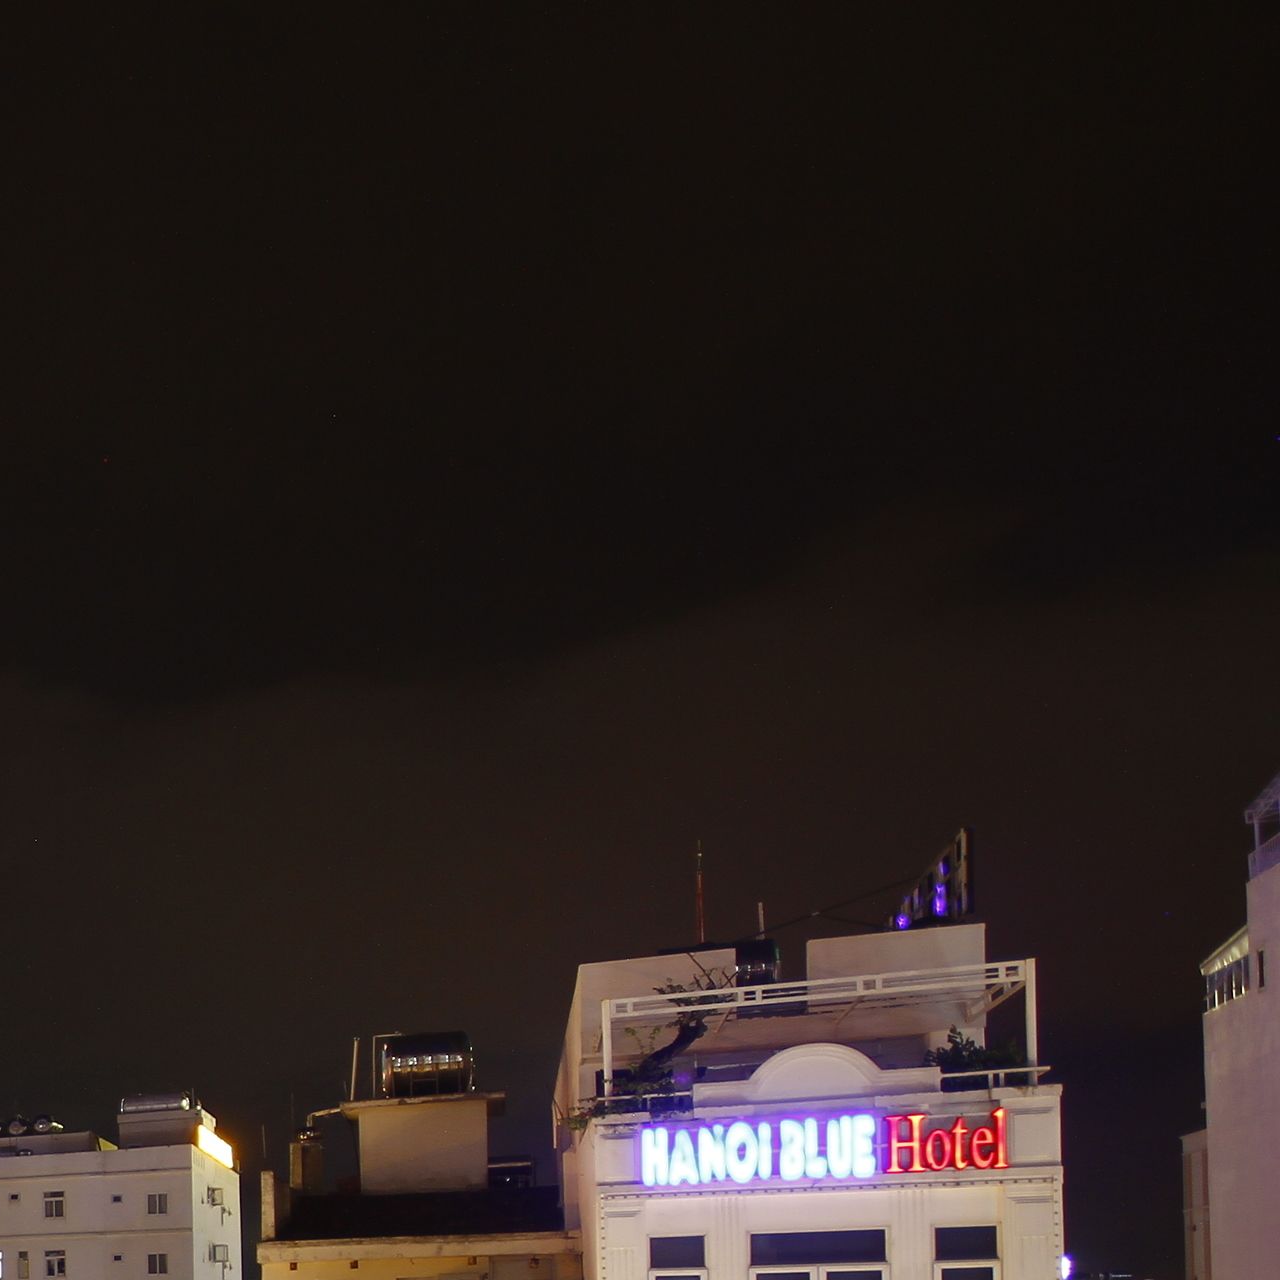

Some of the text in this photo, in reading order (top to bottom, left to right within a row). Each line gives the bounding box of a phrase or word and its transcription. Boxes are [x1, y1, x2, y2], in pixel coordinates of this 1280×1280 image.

[641, 1107, 1010, 1187] HANOI BLUE Hotel
